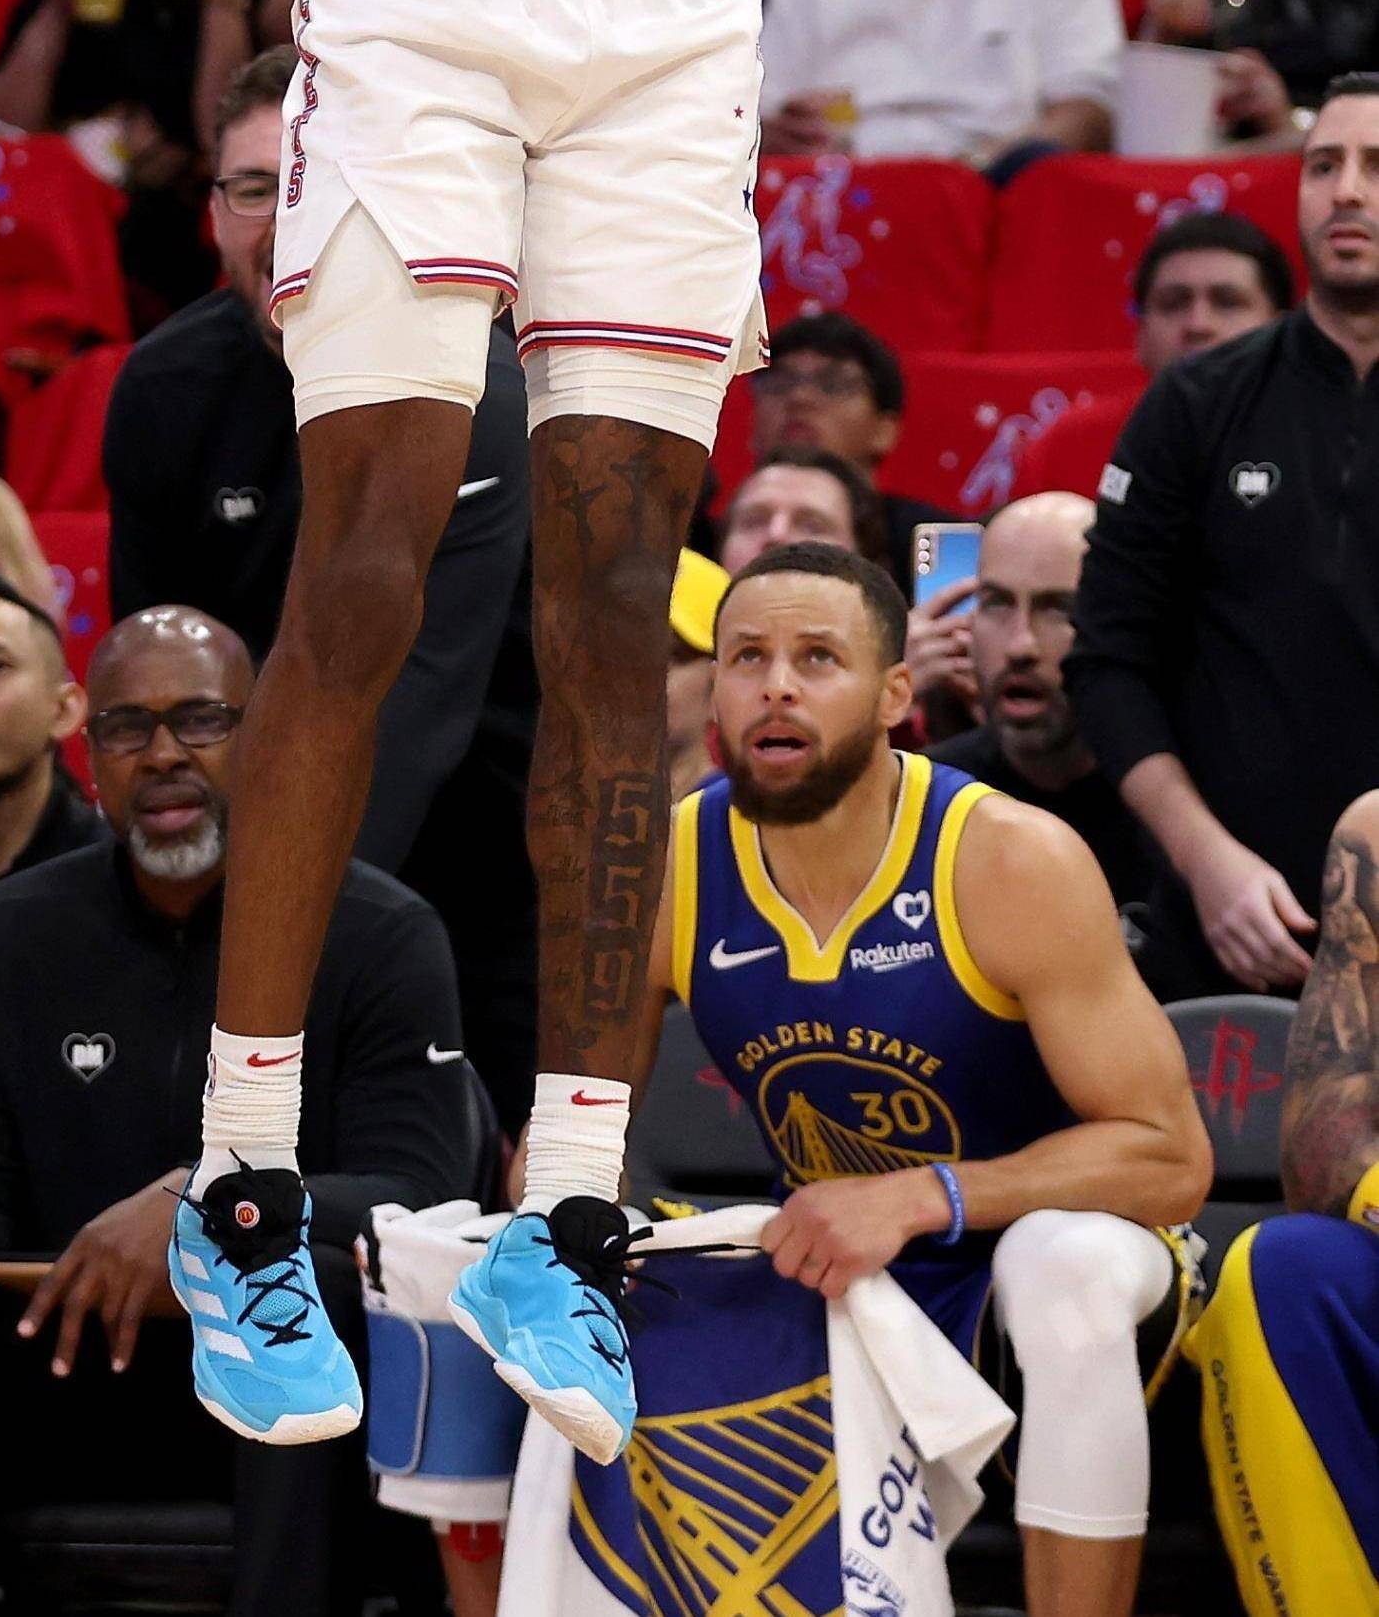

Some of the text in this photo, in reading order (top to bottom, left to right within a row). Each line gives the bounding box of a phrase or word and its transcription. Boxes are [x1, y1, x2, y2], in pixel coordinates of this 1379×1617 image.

[849, 940, 935, 973] Rakuten
[736, 1021, 943, 1077] GOLDEN STATE
[850, 1089, 932, 1140] 30
[1233, 1471, 1264, 1543] STATE
